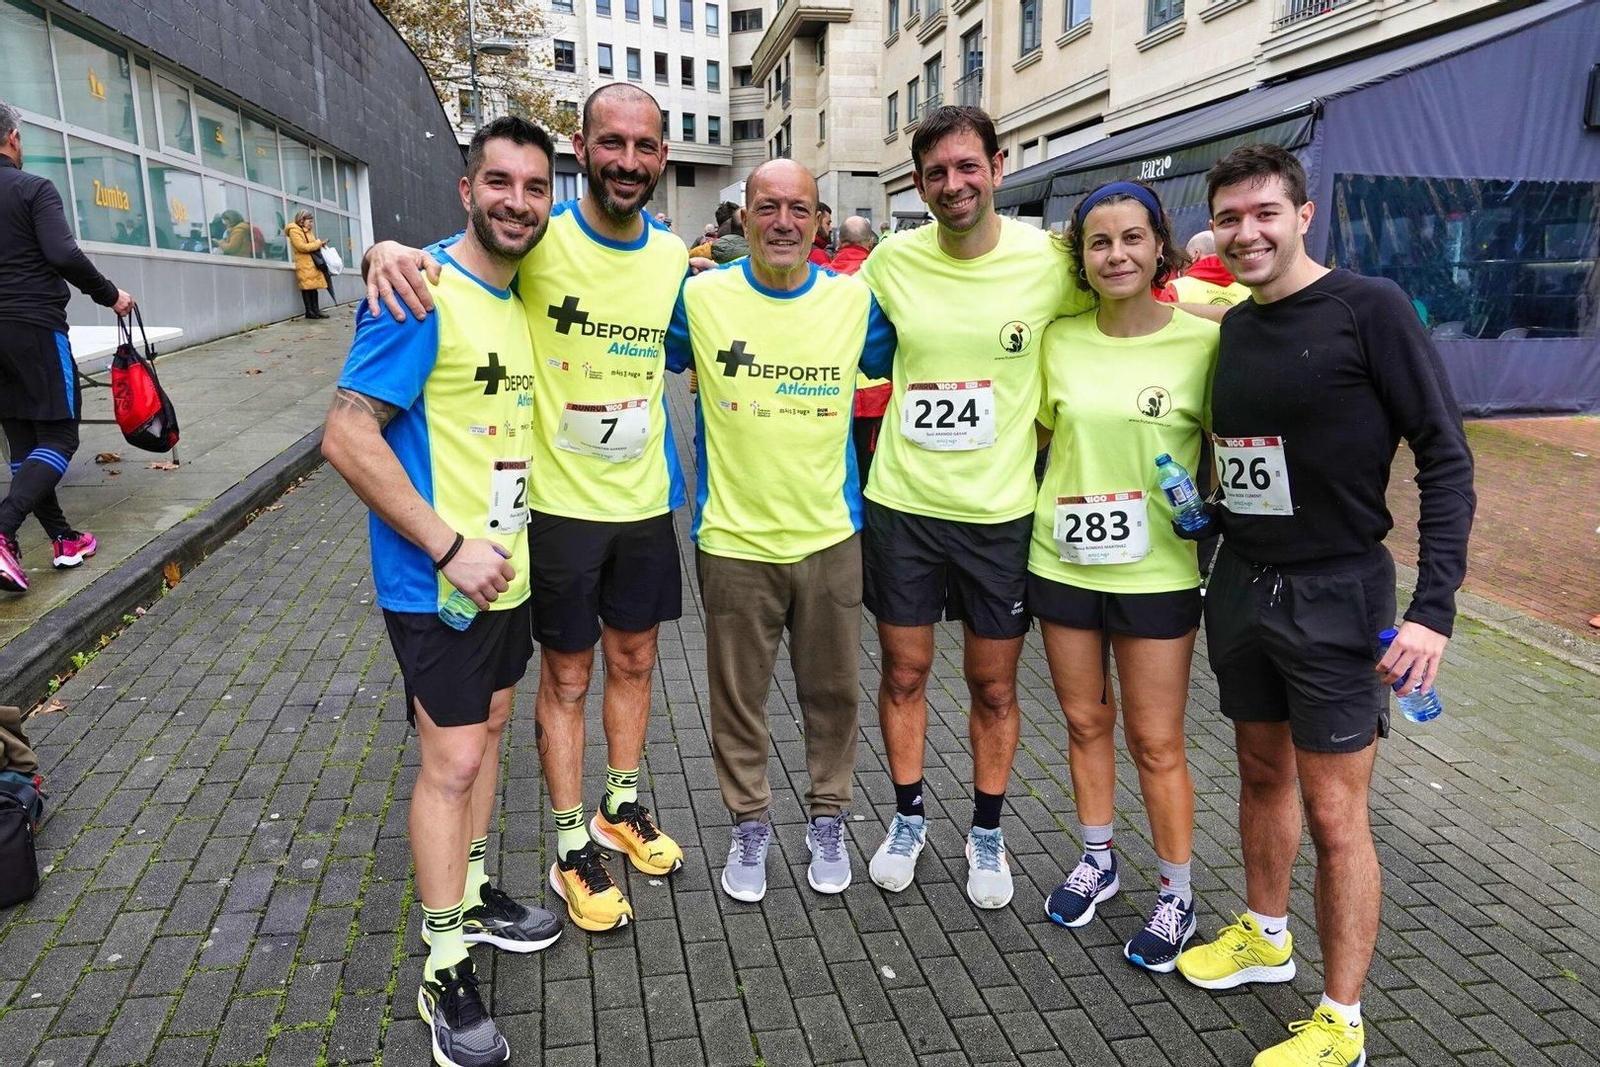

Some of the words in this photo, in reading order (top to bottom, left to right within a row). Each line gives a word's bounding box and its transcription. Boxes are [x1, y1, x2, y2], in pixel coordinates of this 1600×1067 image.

[93, 179, 130, 211] Zumba
[581, 321, 665, 343] DEPORTE
[606, 341, 659, 358] Atlántic
[747, 362, 841, 381] DEPORTE
[775, 381, 840, 396] Atlántico
[914, 398, 980, 429] 224
[600, 417, 619, 444] 7
[1218, 455, 1271, 491] 226
[1065, 510, 1130, 543] 283
